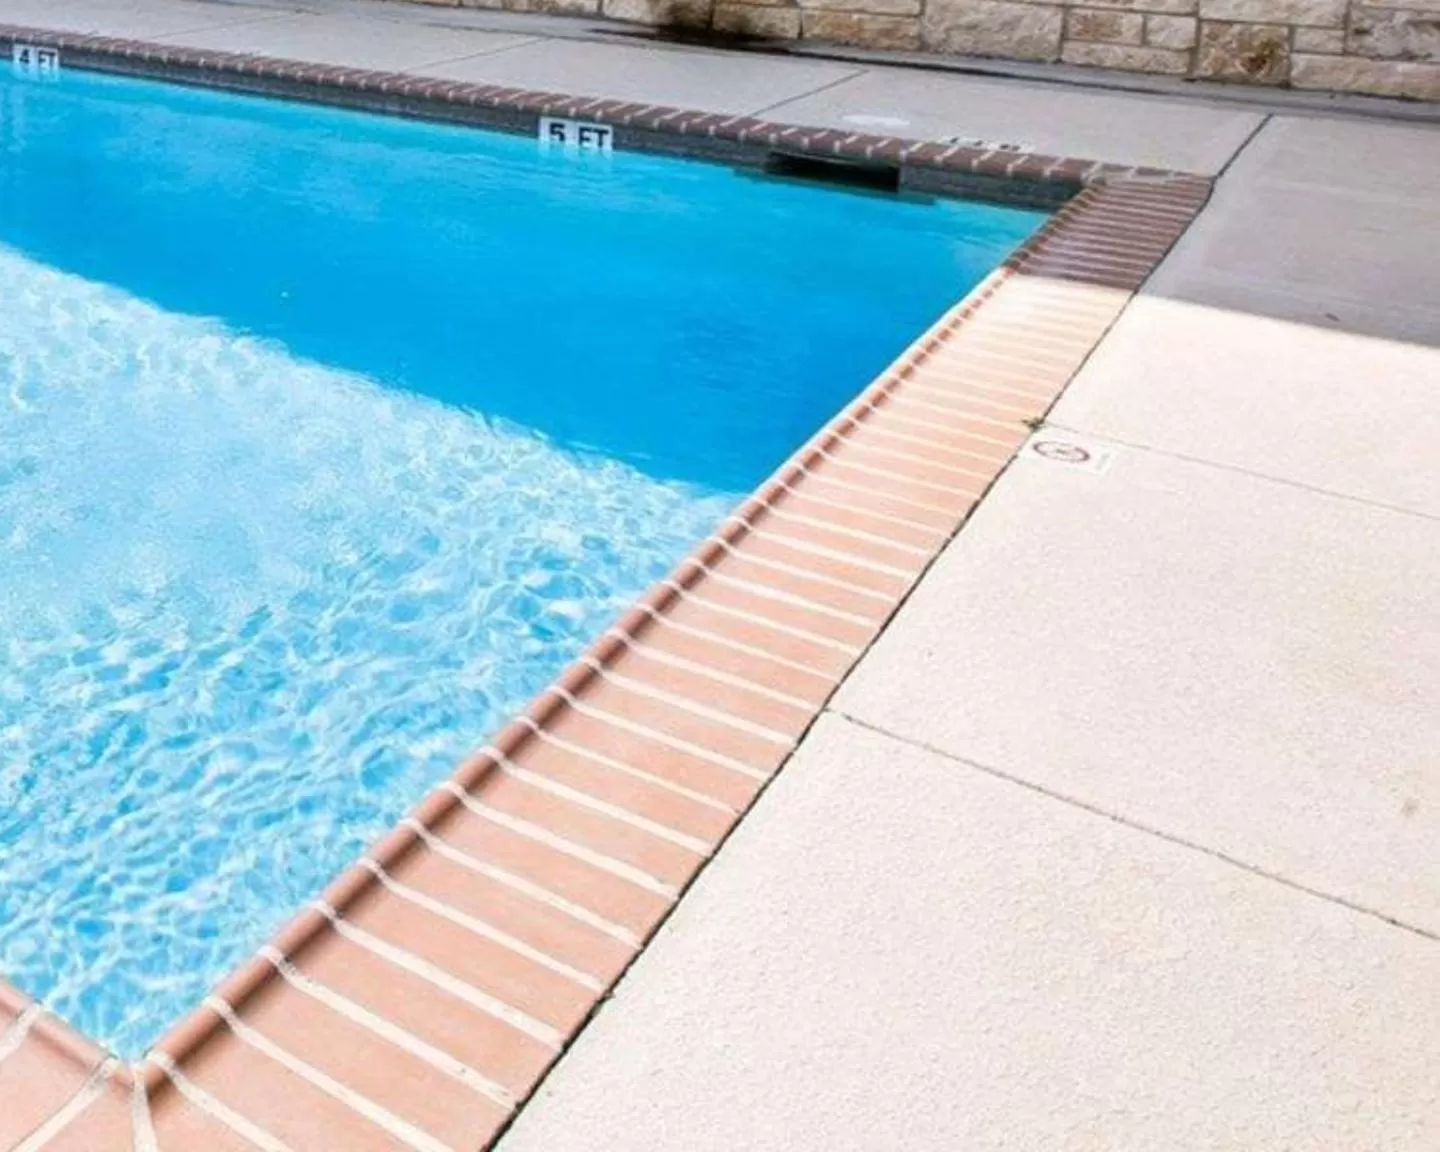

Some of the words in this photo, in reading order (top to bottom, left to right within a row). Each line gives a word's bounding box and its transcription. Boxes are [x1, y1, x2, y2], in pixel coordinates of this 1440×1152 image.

[36, 49, 55, 67] FT
[548, 121, 566, 142] 5
[578, 125, 609, 147] FT
